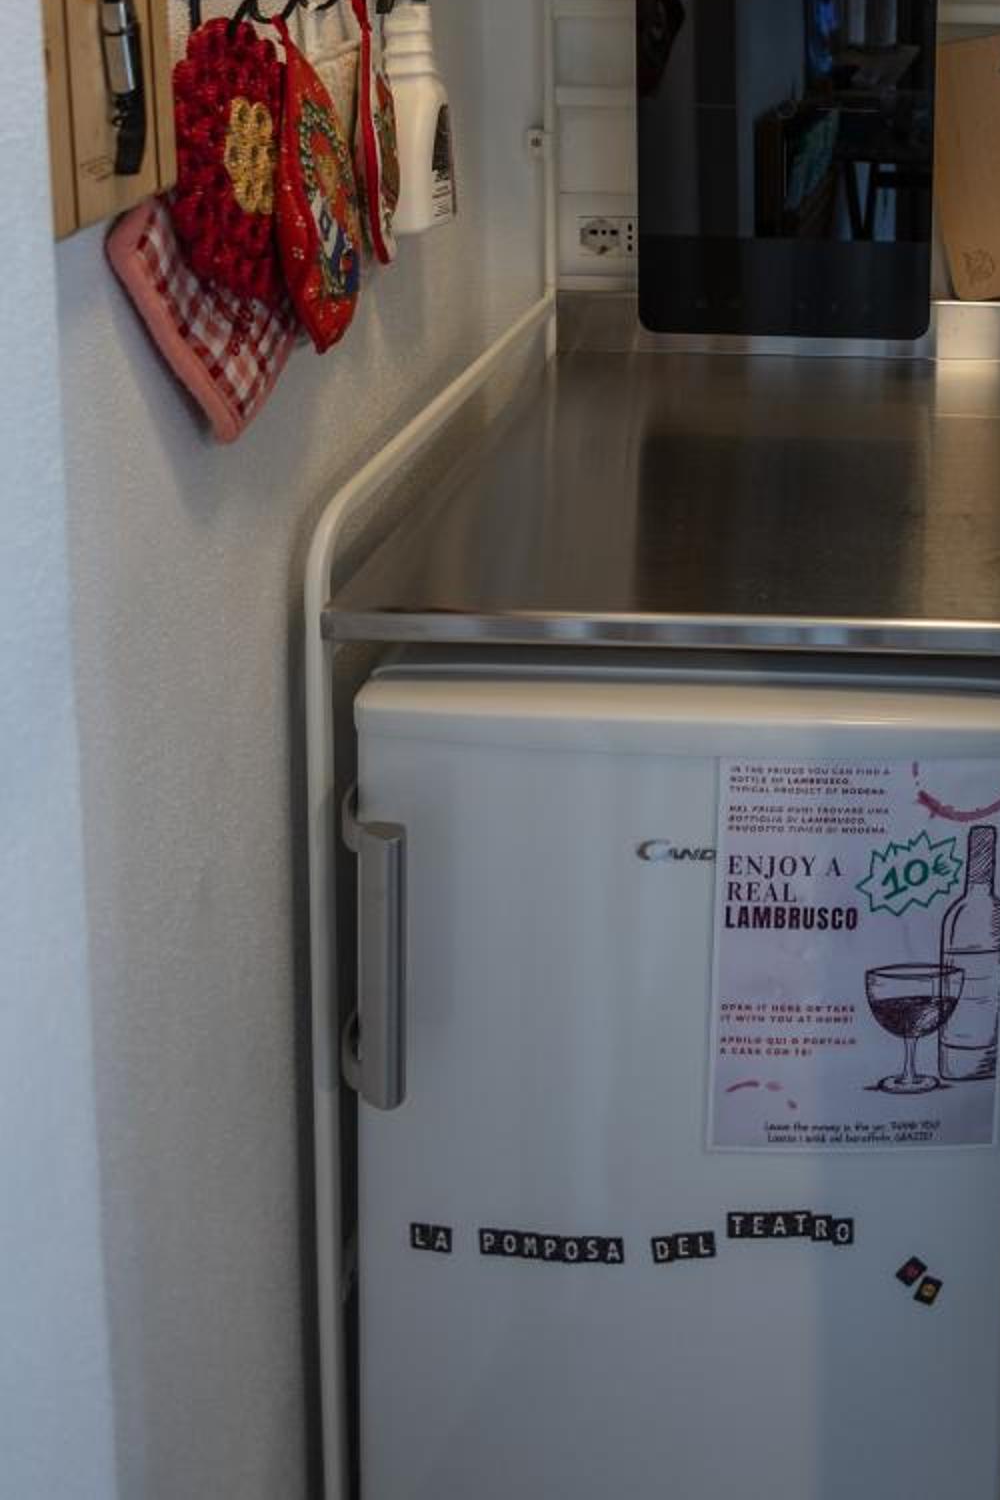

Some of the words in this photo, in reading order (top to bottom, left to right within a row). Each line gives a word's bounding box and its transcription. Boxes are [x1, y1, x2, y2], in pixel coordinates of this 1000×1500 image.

[636, 839, 716, 861] CAND
[728, 855, 816, 879] ENJOY
[826, 858, 842, 877] A
[881, 853, 952, 900] 10€
[727, 881, 796, 903] REAL
[725, 906, 858, 930] LAMBRUSCO
[412, 1225, 451, 1252] LA
[482, 1231, 622, 1263] POMPOSA
[654, 1234, 714, 1262] DEL
[730, 1213, 852, 1244] TEATRO
